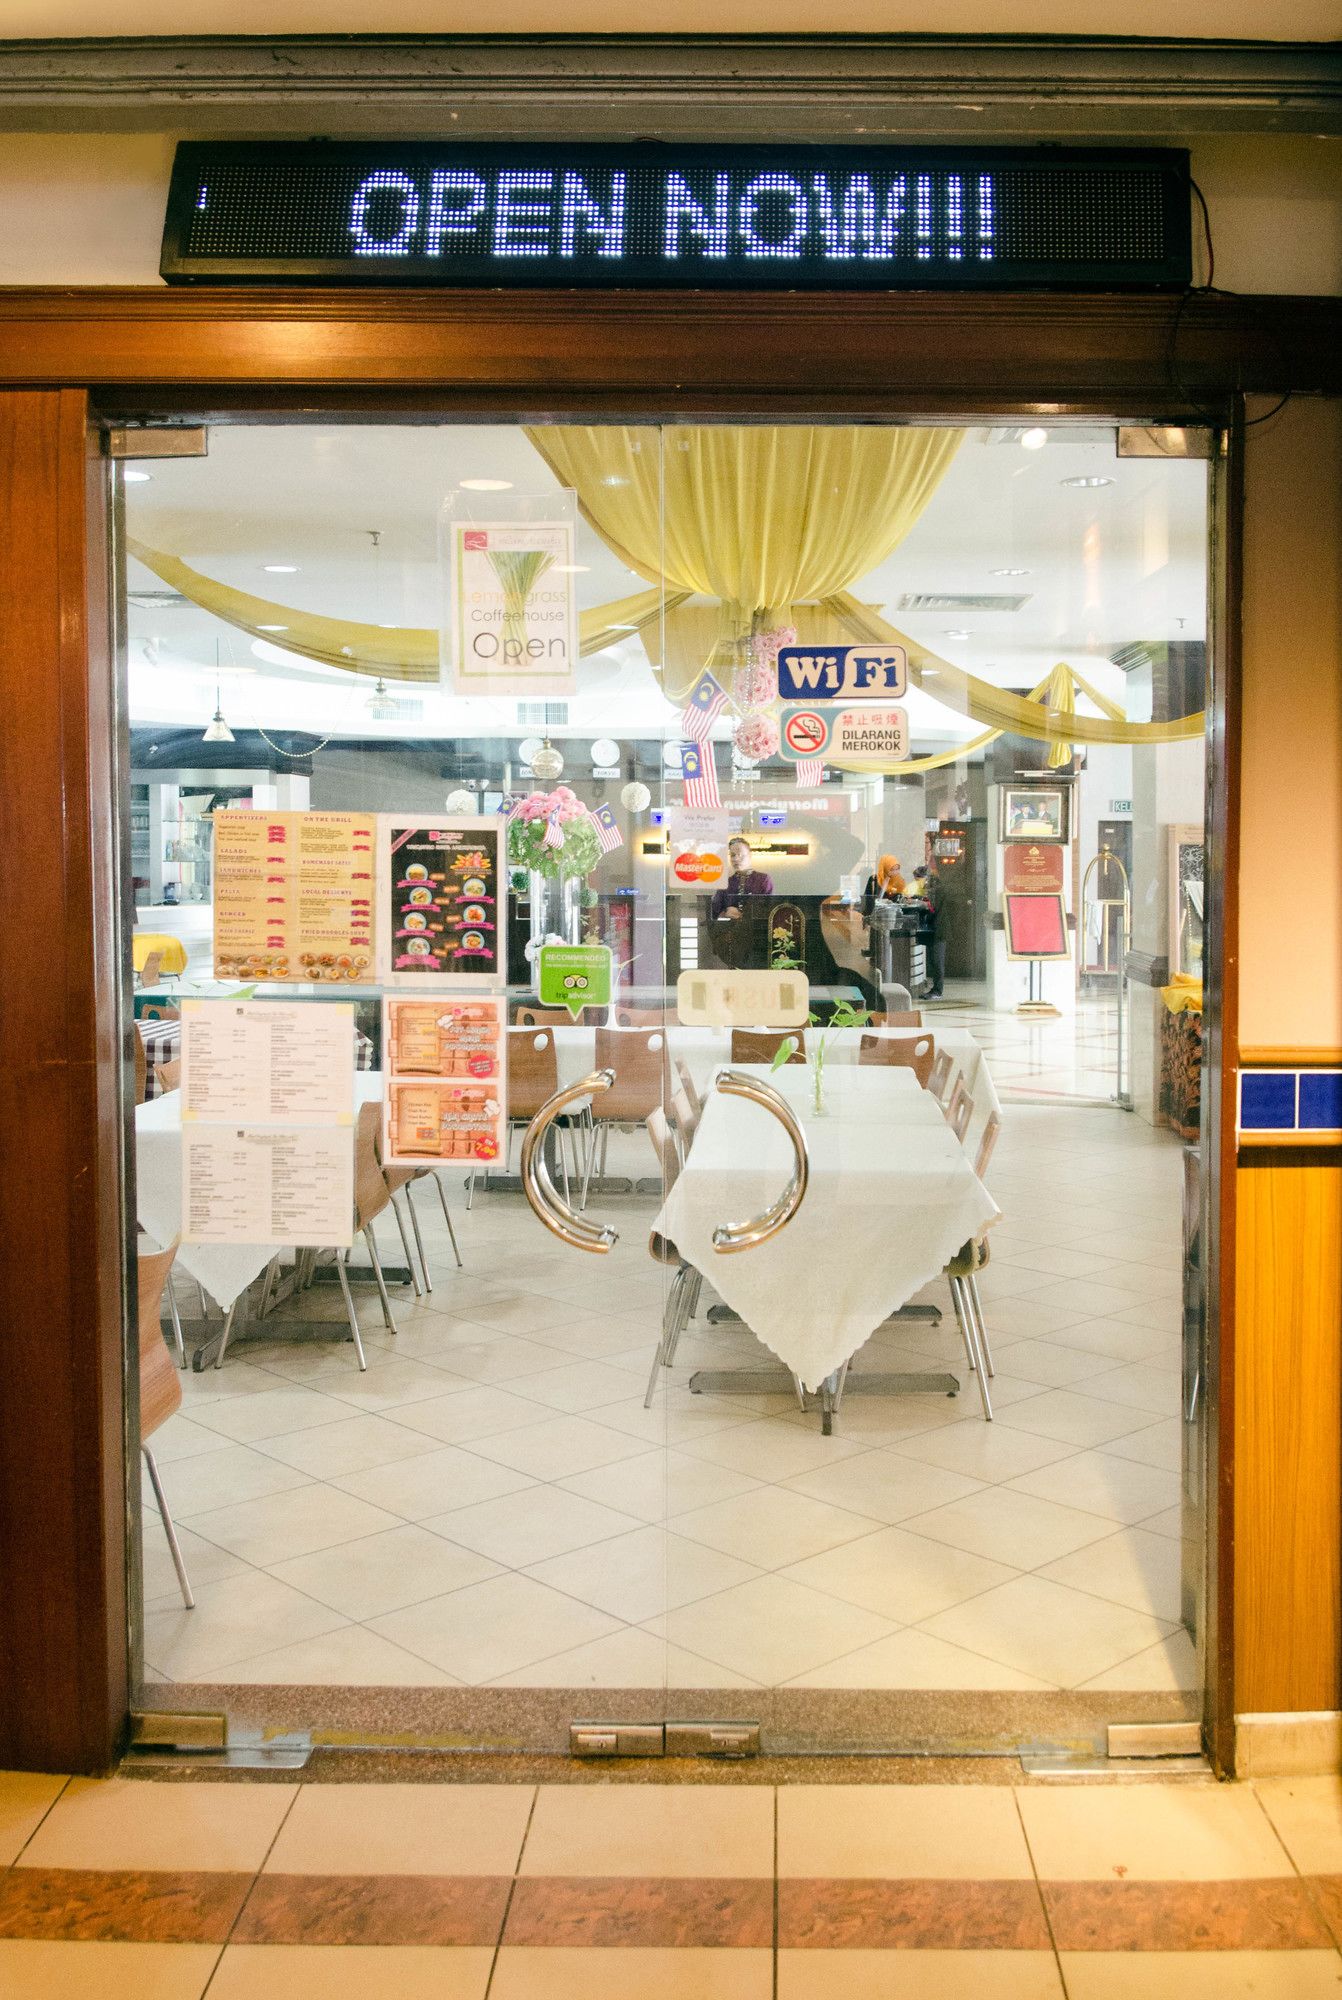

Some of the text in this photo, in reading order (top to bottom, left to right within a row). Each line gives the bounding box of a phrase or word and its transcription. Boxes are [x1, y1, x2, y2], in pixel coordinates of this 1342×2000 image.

[349, 170, 996, 261] OPEN NOW!!!
[471, 609, 565, 621] Coffeehouse
[473, 632, 566, 662] Open
[842, 730, 901, 740] DILARANG
[842, 741, 901, 751] MEROKOK
[1115, 801, 1133, 812] KEL
[676, 863, 722, 873] MasterCard
